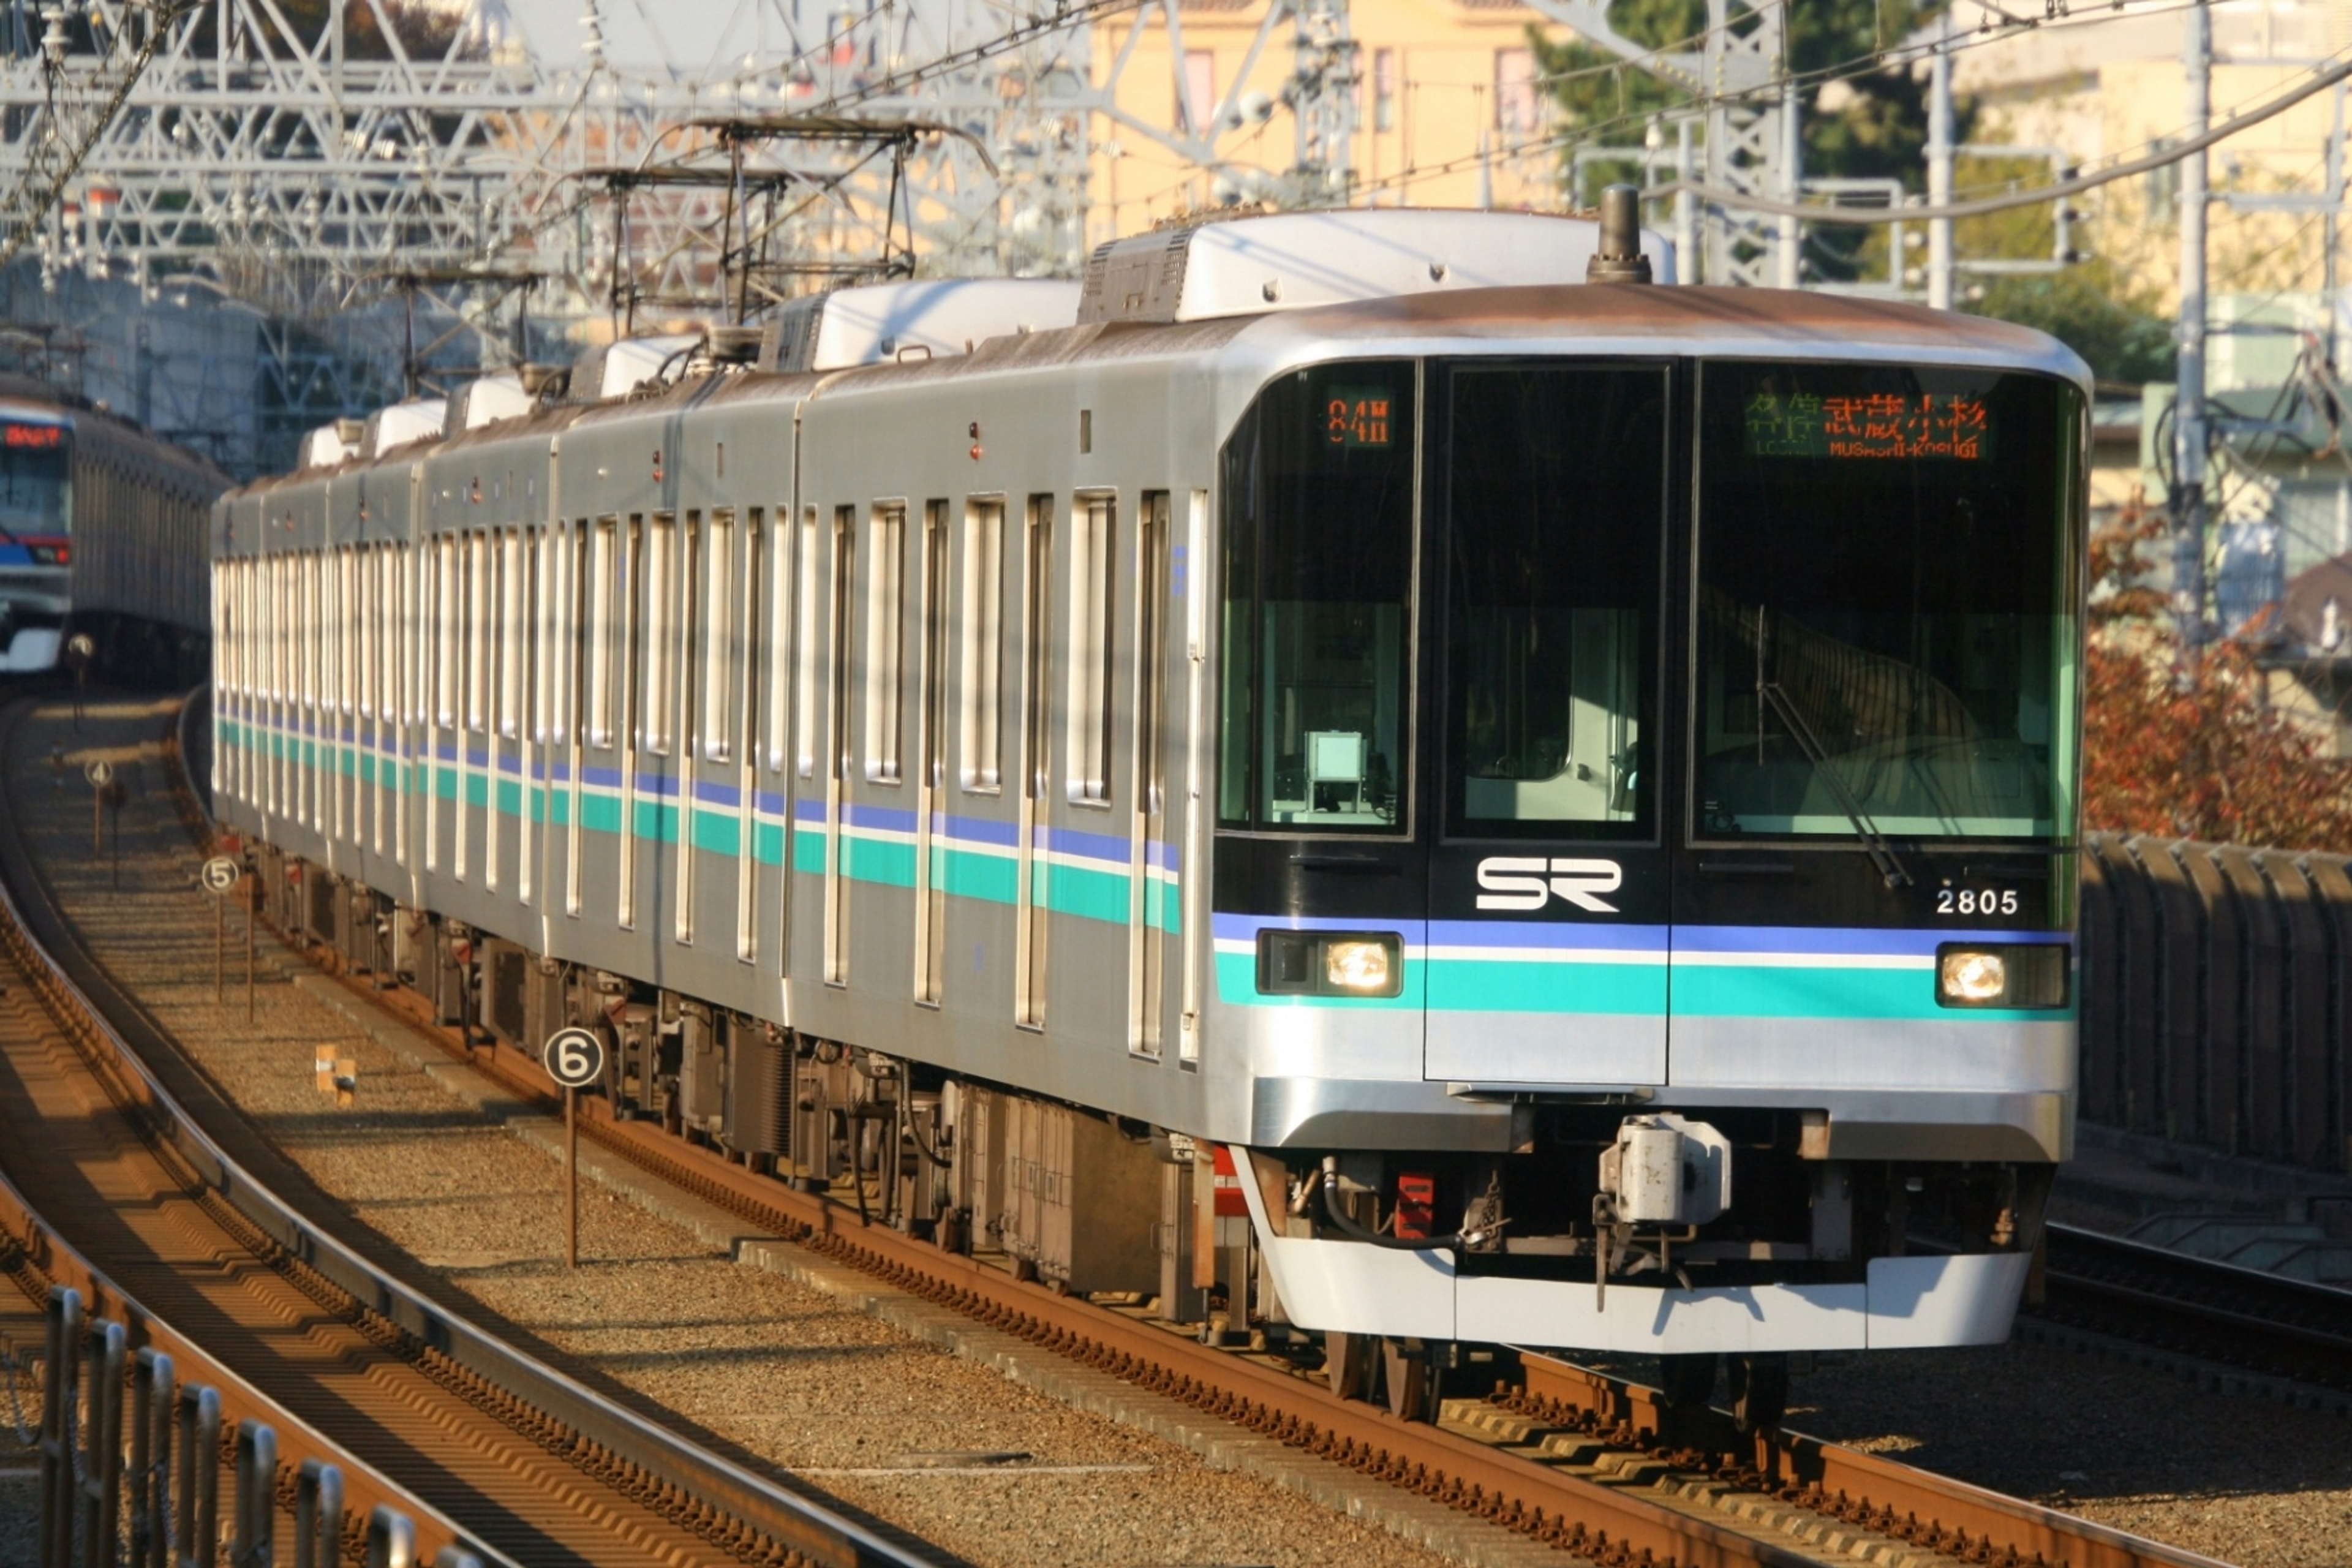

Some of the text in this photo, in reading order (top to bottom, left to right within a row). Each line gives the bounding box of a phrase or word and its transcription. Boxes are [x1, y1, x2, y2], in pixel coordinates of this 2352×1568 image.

[211, 862, 230, 888] 5
[1476, 857, 1622, 913] SR
[1936, 889, 2018, 915] 2805
[559, 1037, 588, 1077] 6
